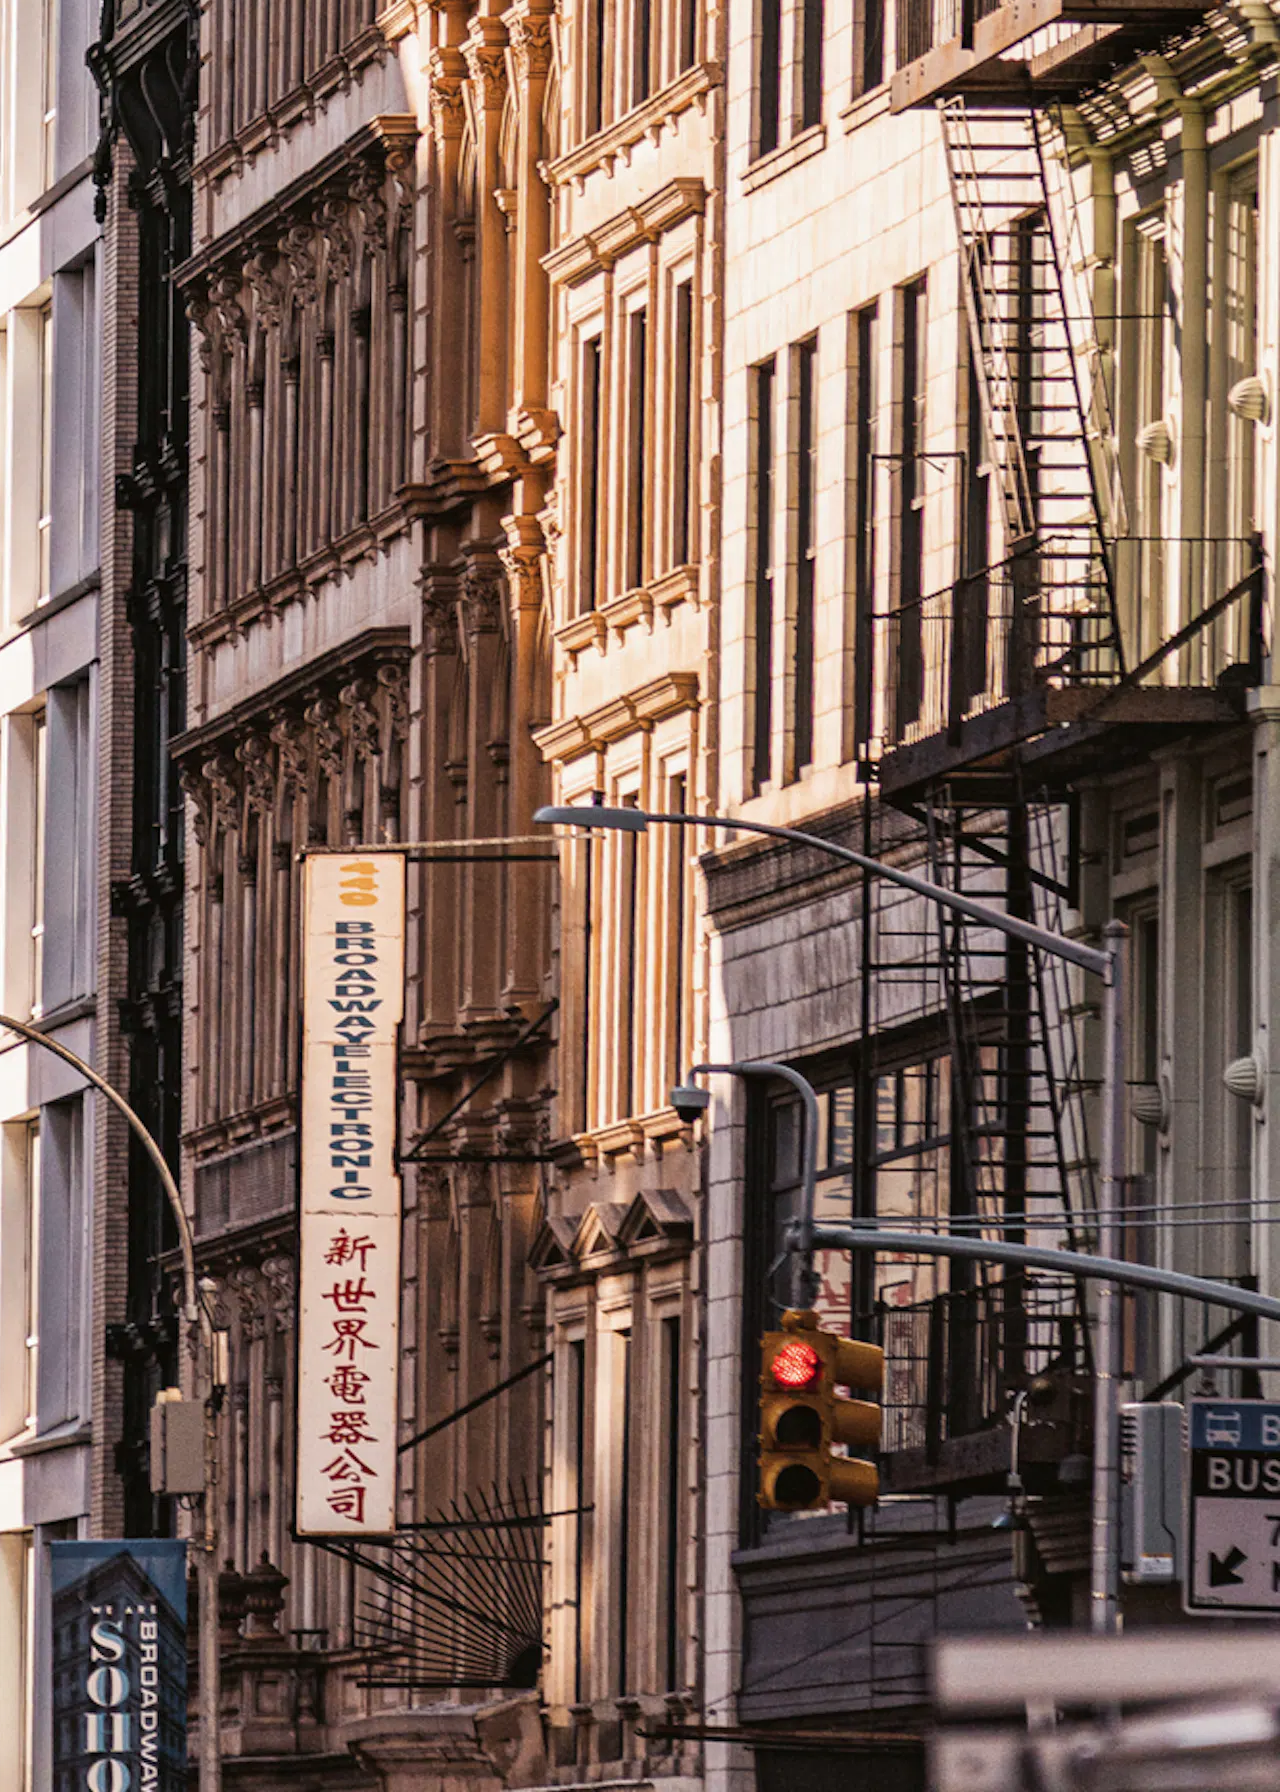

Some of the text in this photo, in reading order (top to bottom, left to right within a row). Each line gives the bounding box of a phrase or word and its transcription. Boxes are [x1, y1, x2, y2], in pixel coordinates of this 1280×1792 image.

[338, 861, 379, 906] 440
[318, 1227, 380, 1524] 新世界電器公司
[1207, 1457, 1280, 1493] BUS
[91, 1604, 157, 1615] WE ARE
[84, 1620, 131, 1792] SOHO
